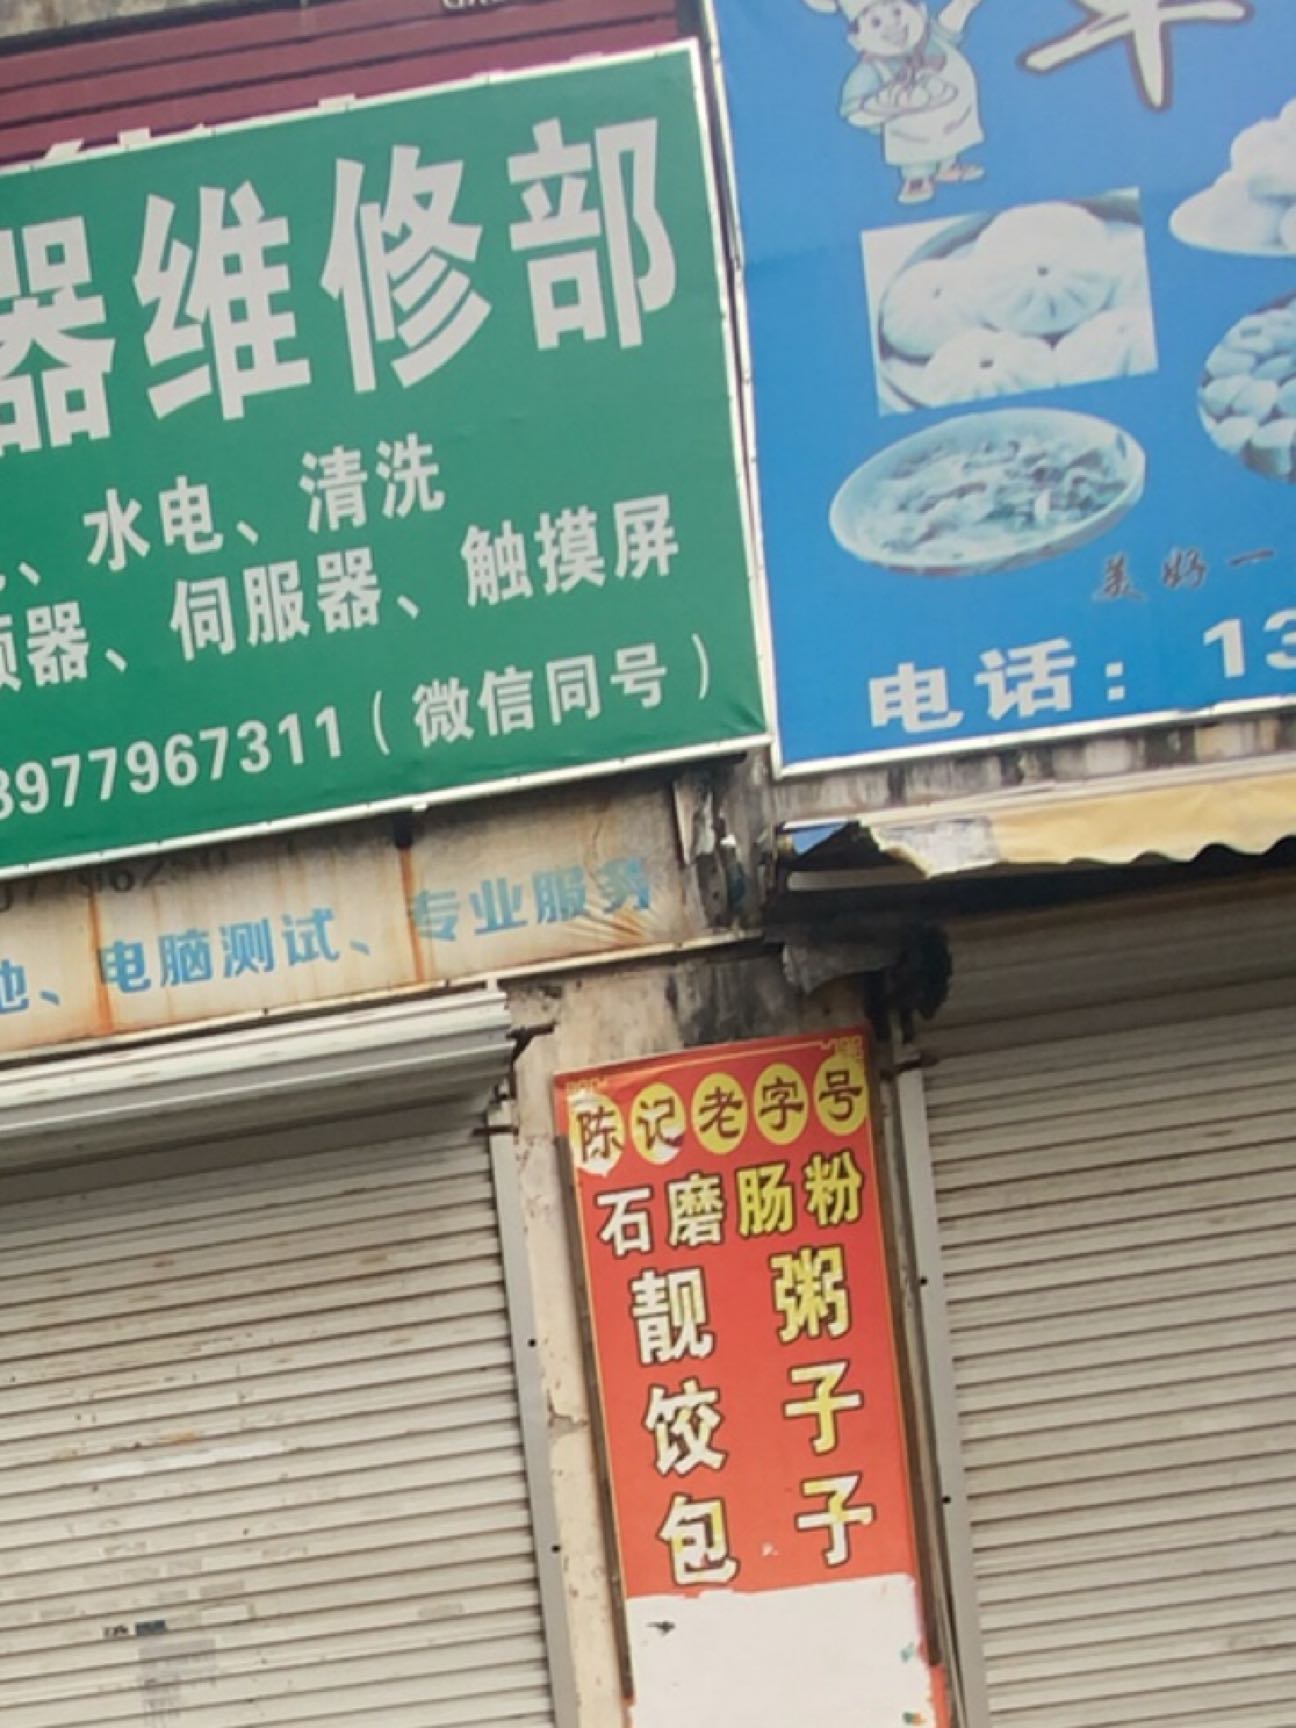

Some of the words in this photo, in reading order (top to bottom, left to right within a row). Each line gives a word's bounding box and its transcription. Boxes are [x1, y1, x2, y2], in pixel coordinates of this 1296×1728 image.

[576, 1068, 864, 1164] 陈记老字号
[596, 1150, 865, 1258] 石磨肠粉
